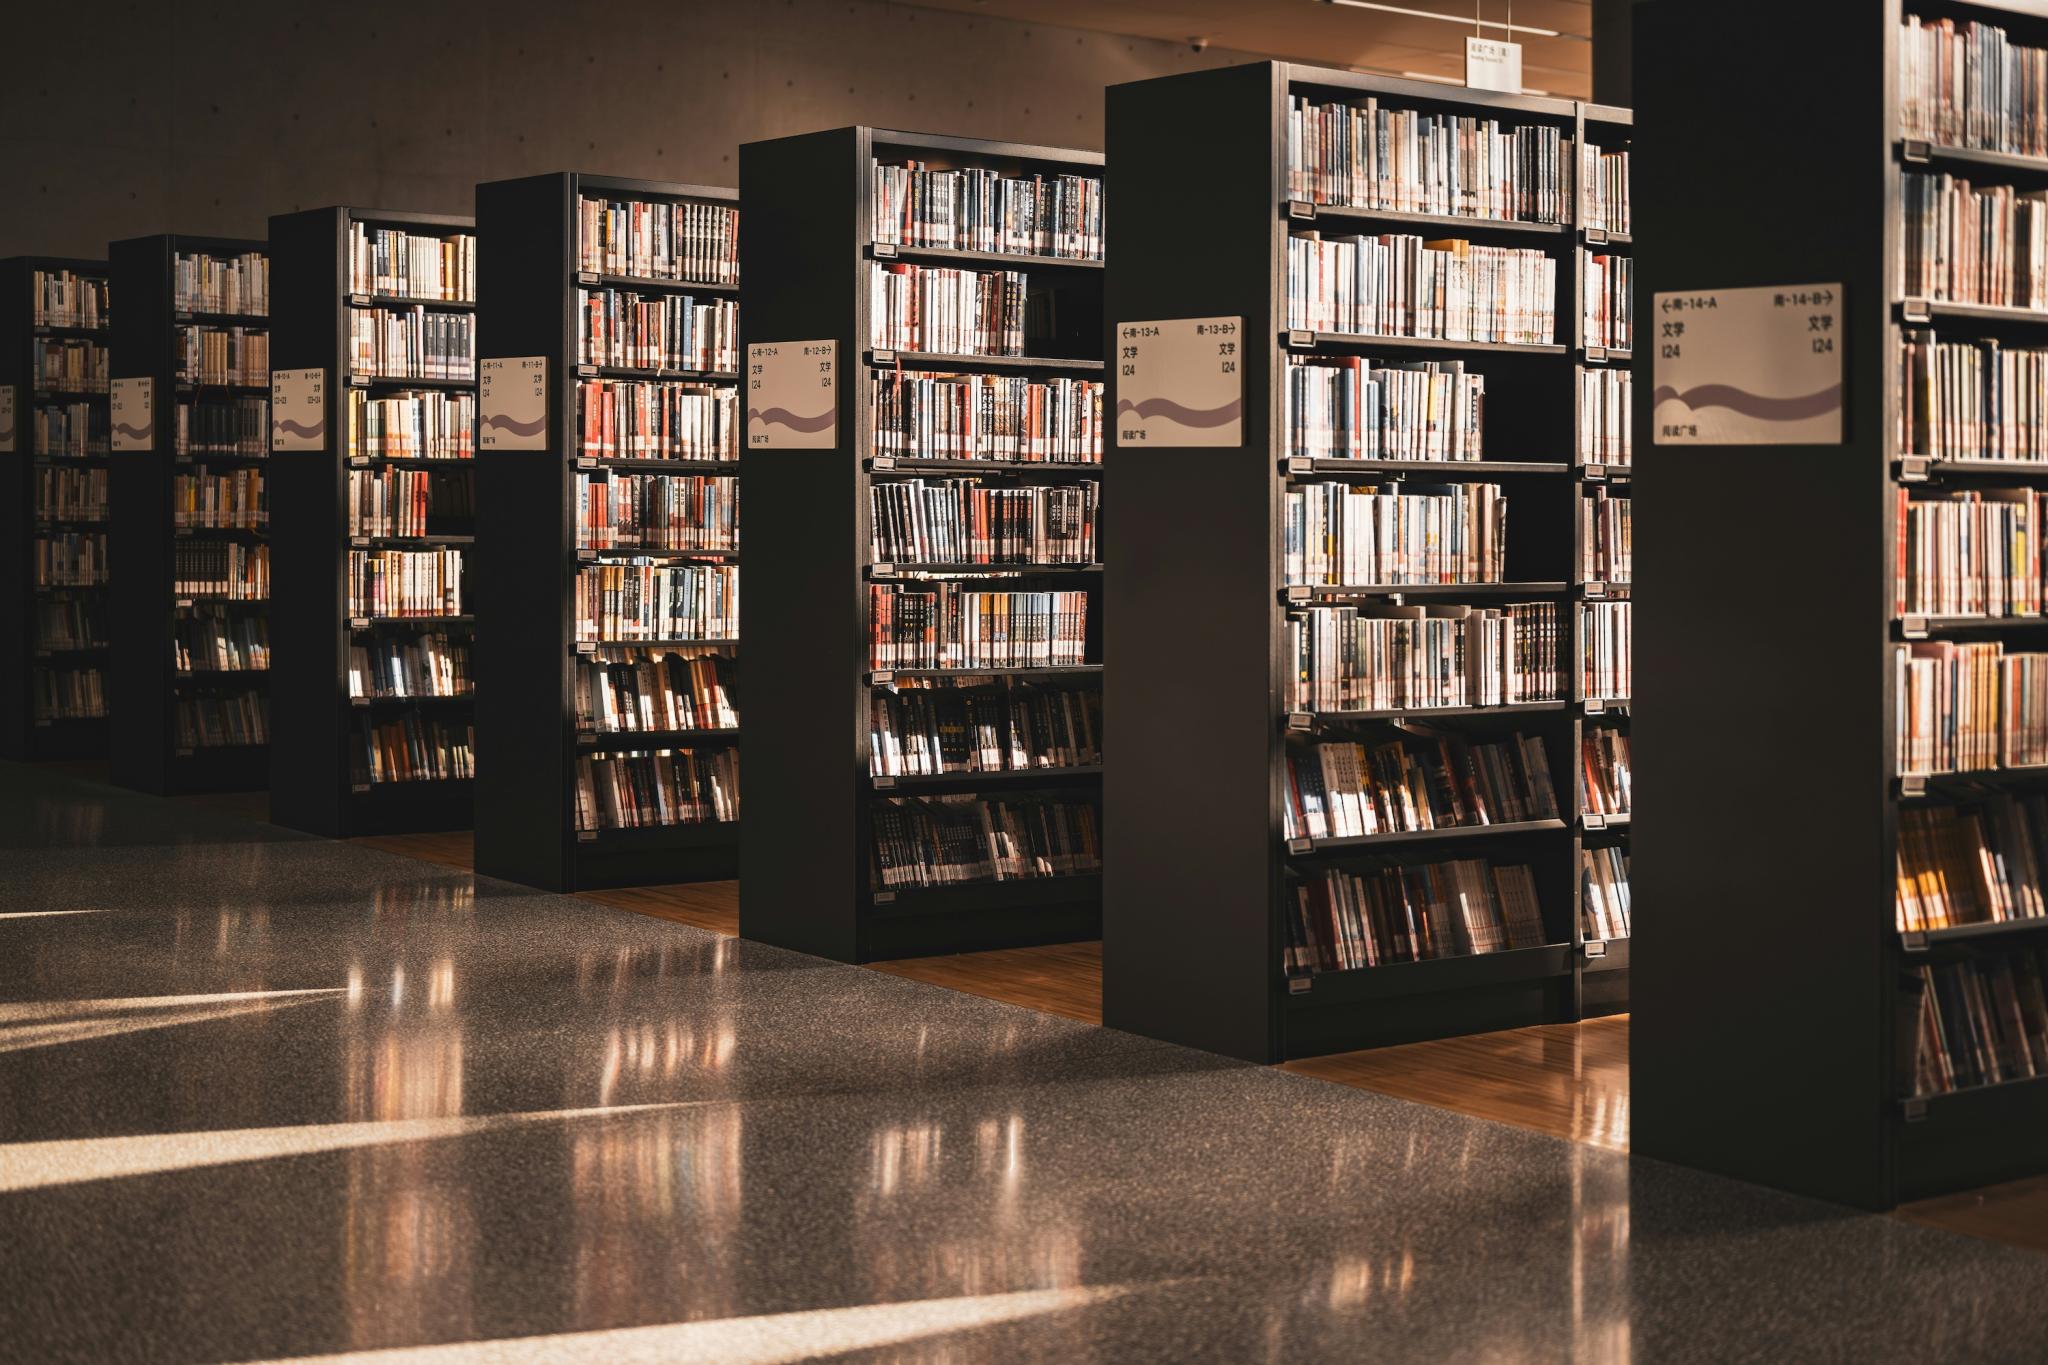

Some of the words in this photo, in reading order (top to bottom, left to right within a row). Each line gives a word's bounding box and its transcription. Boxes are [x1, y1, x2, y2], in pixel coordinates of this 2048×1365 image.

[1662, 322, 1685, 338] 文学
[1808, 315, 1833, 332] 文学
[1122, 346, 1138, 359] 文学
[1219, 343, 1236, 356] 文学
[752, 364, 763, 375] 文学
[819, 361, 832, 373] 文学
